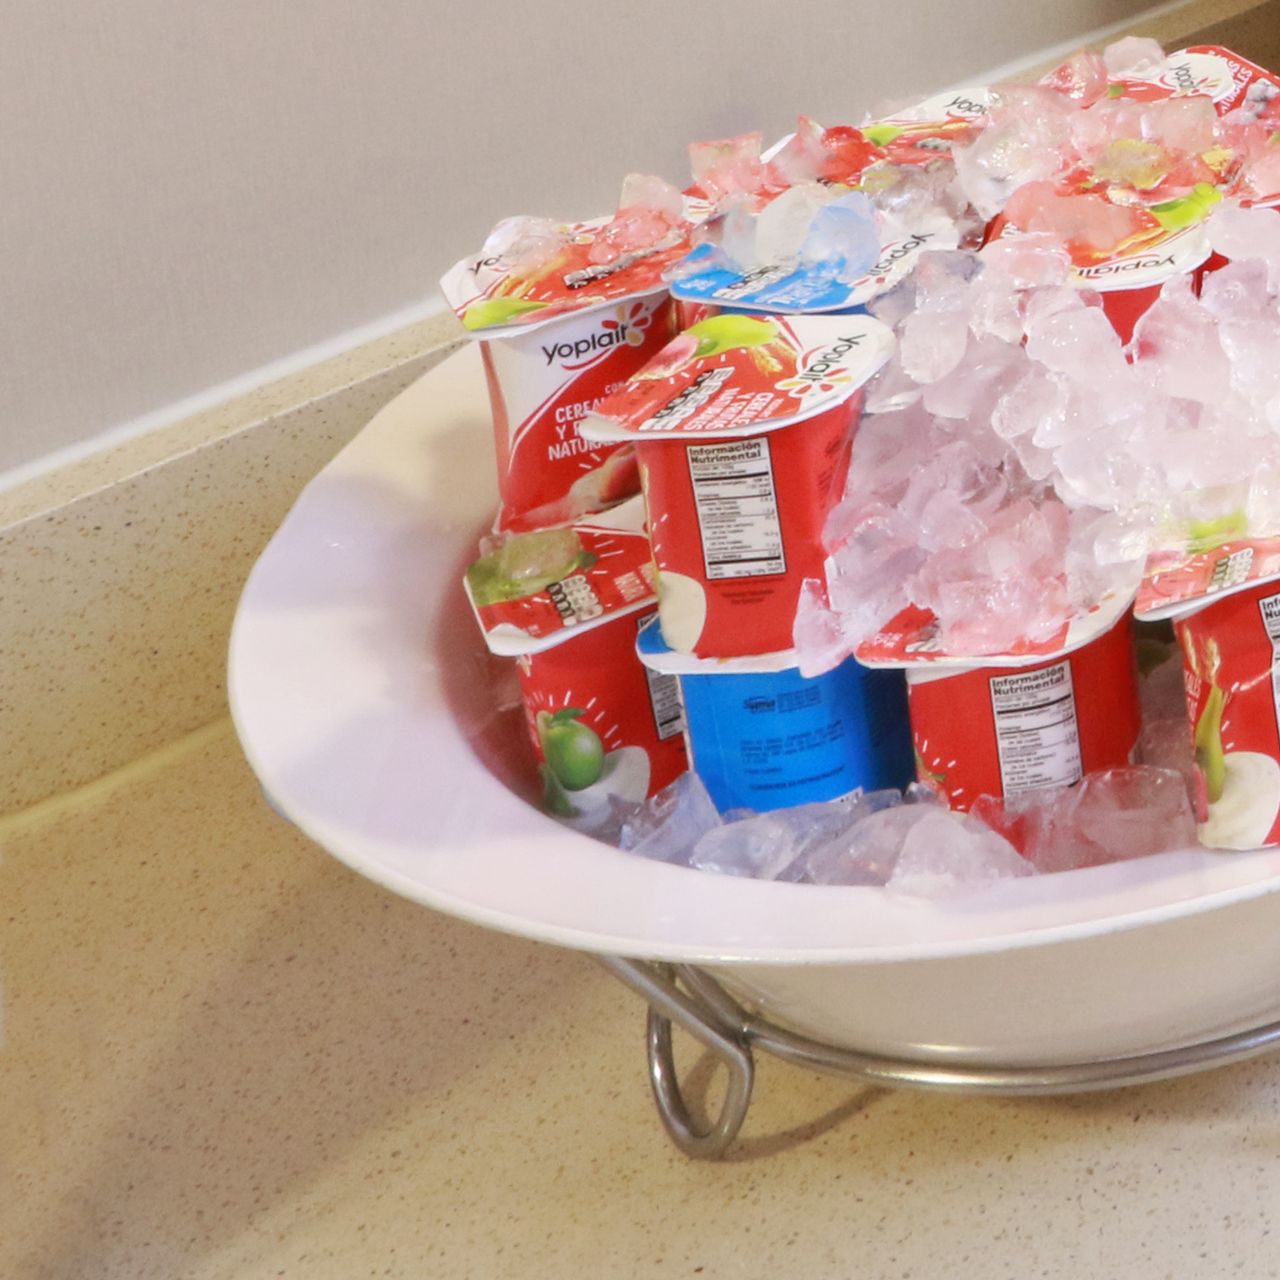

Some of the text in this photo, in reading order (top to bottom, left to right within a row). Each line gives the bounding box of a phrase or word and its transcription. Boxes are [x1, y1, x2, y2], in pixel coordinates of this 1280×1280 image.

[556, 397, 606, 423] CEREA
[556, 425, 567, 441] Y
[689, 442, 761, 456] Información
[690, 450, 761, 464] Nutrimental
[992, 665, 1066, 688] Información
[993, 673, 1066, 696] Nutrimental
